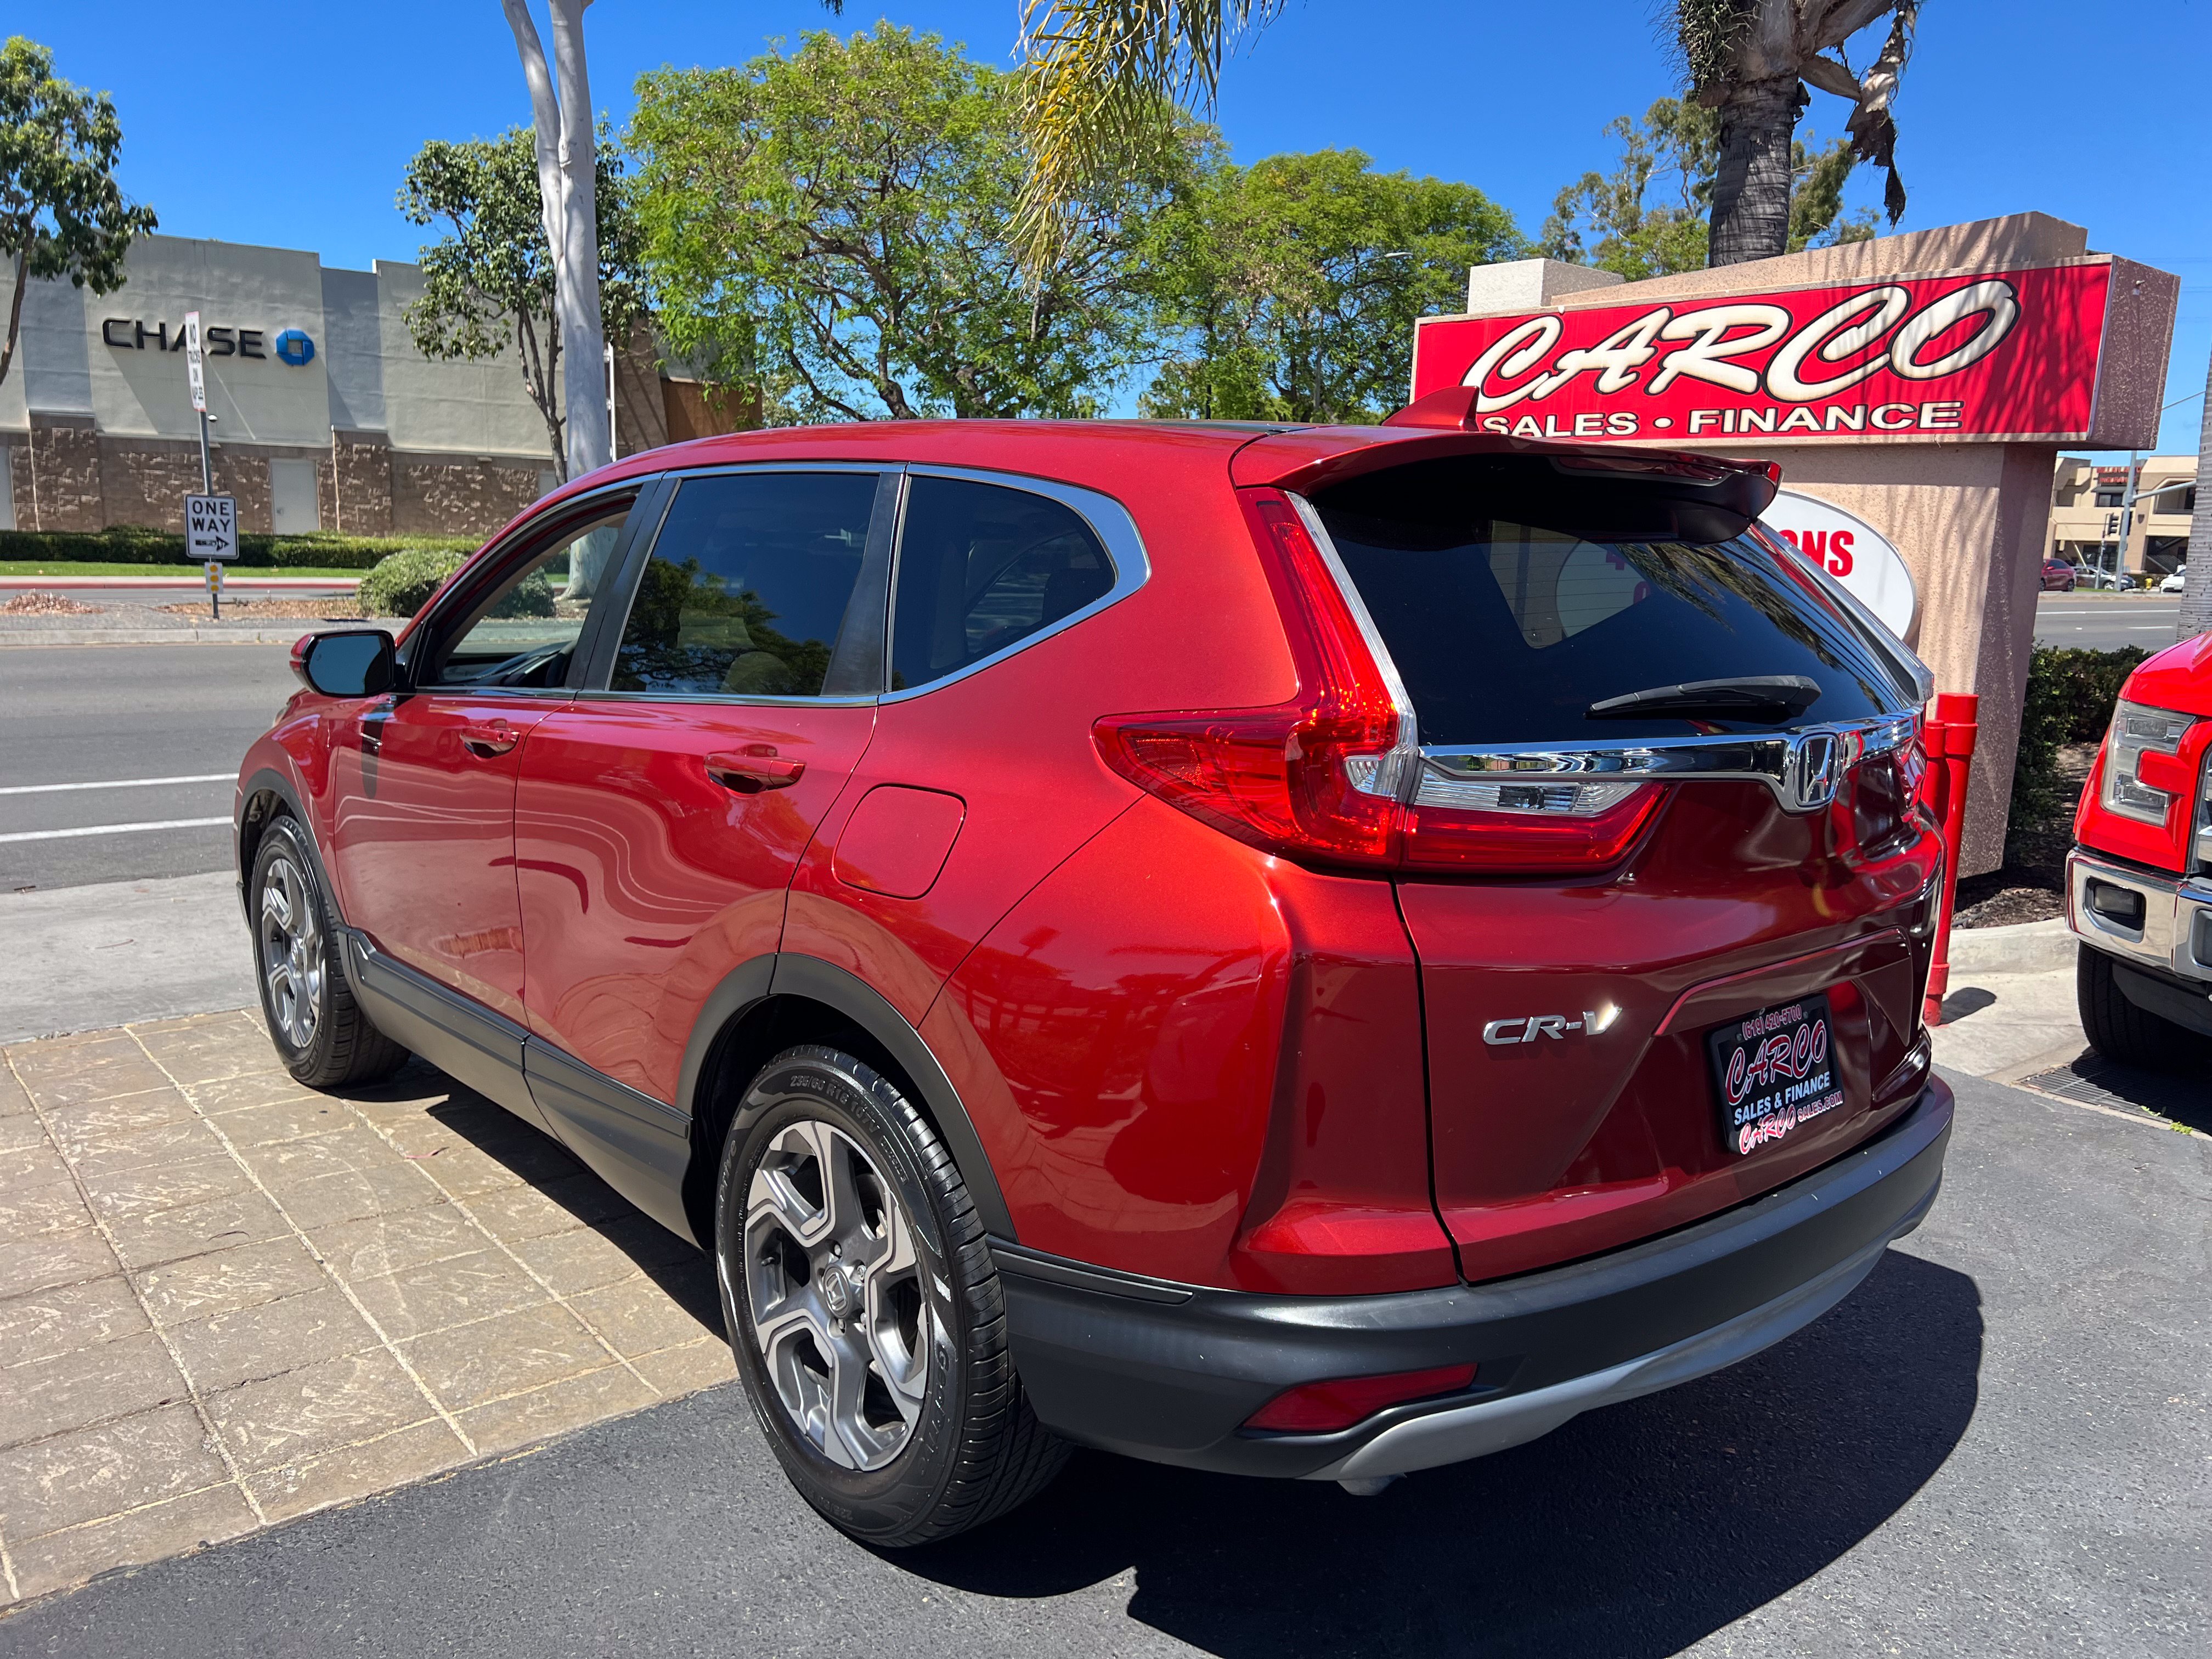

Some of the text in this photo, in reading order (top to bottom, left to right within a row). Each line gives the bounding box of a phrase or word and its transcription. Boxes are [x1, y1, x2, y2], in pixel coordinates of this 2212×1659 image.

[1460, 279, 2021, 414] CARCO
[1482, 401, 1965, 437] SALES FINANCE
[192, 517, 230, 533] WAY
[193, 500, 230, 516] ONE
[1482, 1006, 1623, 1045] CR-V
[1742, 1004, 1803, 1041] (619) 420-5700
[1725, 1019, 1826, 1106] CARCO
[1734, 1071, 1831, 1125] SALES & FINANCE
[1739, 1091, 1843, 1155] CARCO SALES.COM
